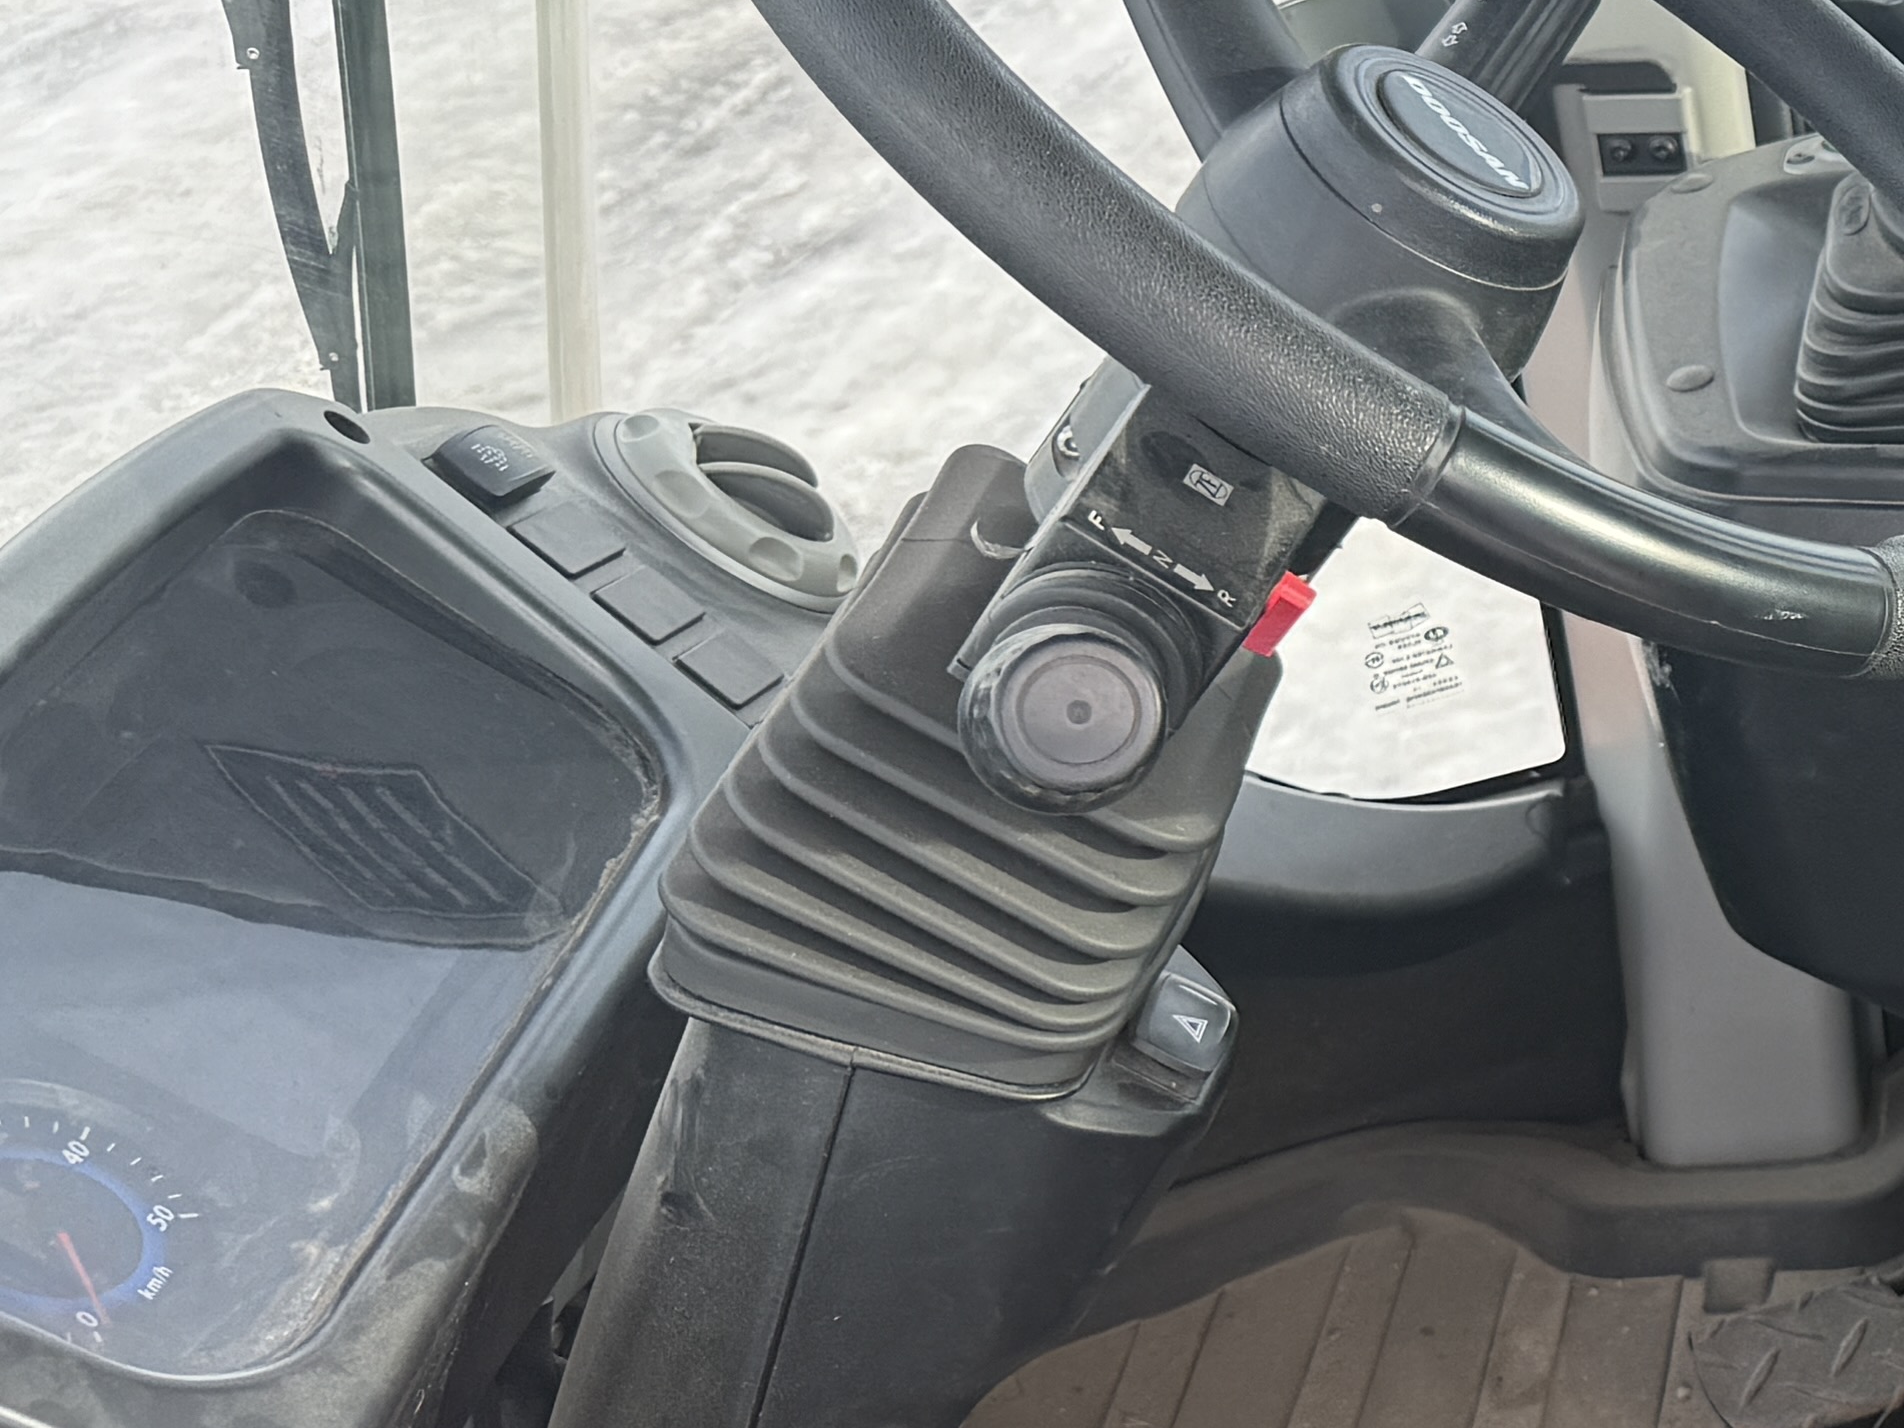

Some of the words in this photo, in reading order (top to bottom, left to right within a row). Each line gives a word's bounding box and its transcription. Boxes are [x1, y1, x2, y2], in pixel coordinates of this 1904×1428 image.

[1401, 74, 1530, 191] DOOSAN
[1087, 509, 1107, 531] F
[1217, 589, 1236, 608] R
[62, 1140, 90, 1166] 40
[146, 1204, 175, 1232] 50
[137, 1265, 174, 1301] km/h
[75, 1311, 99, 1328] 0
